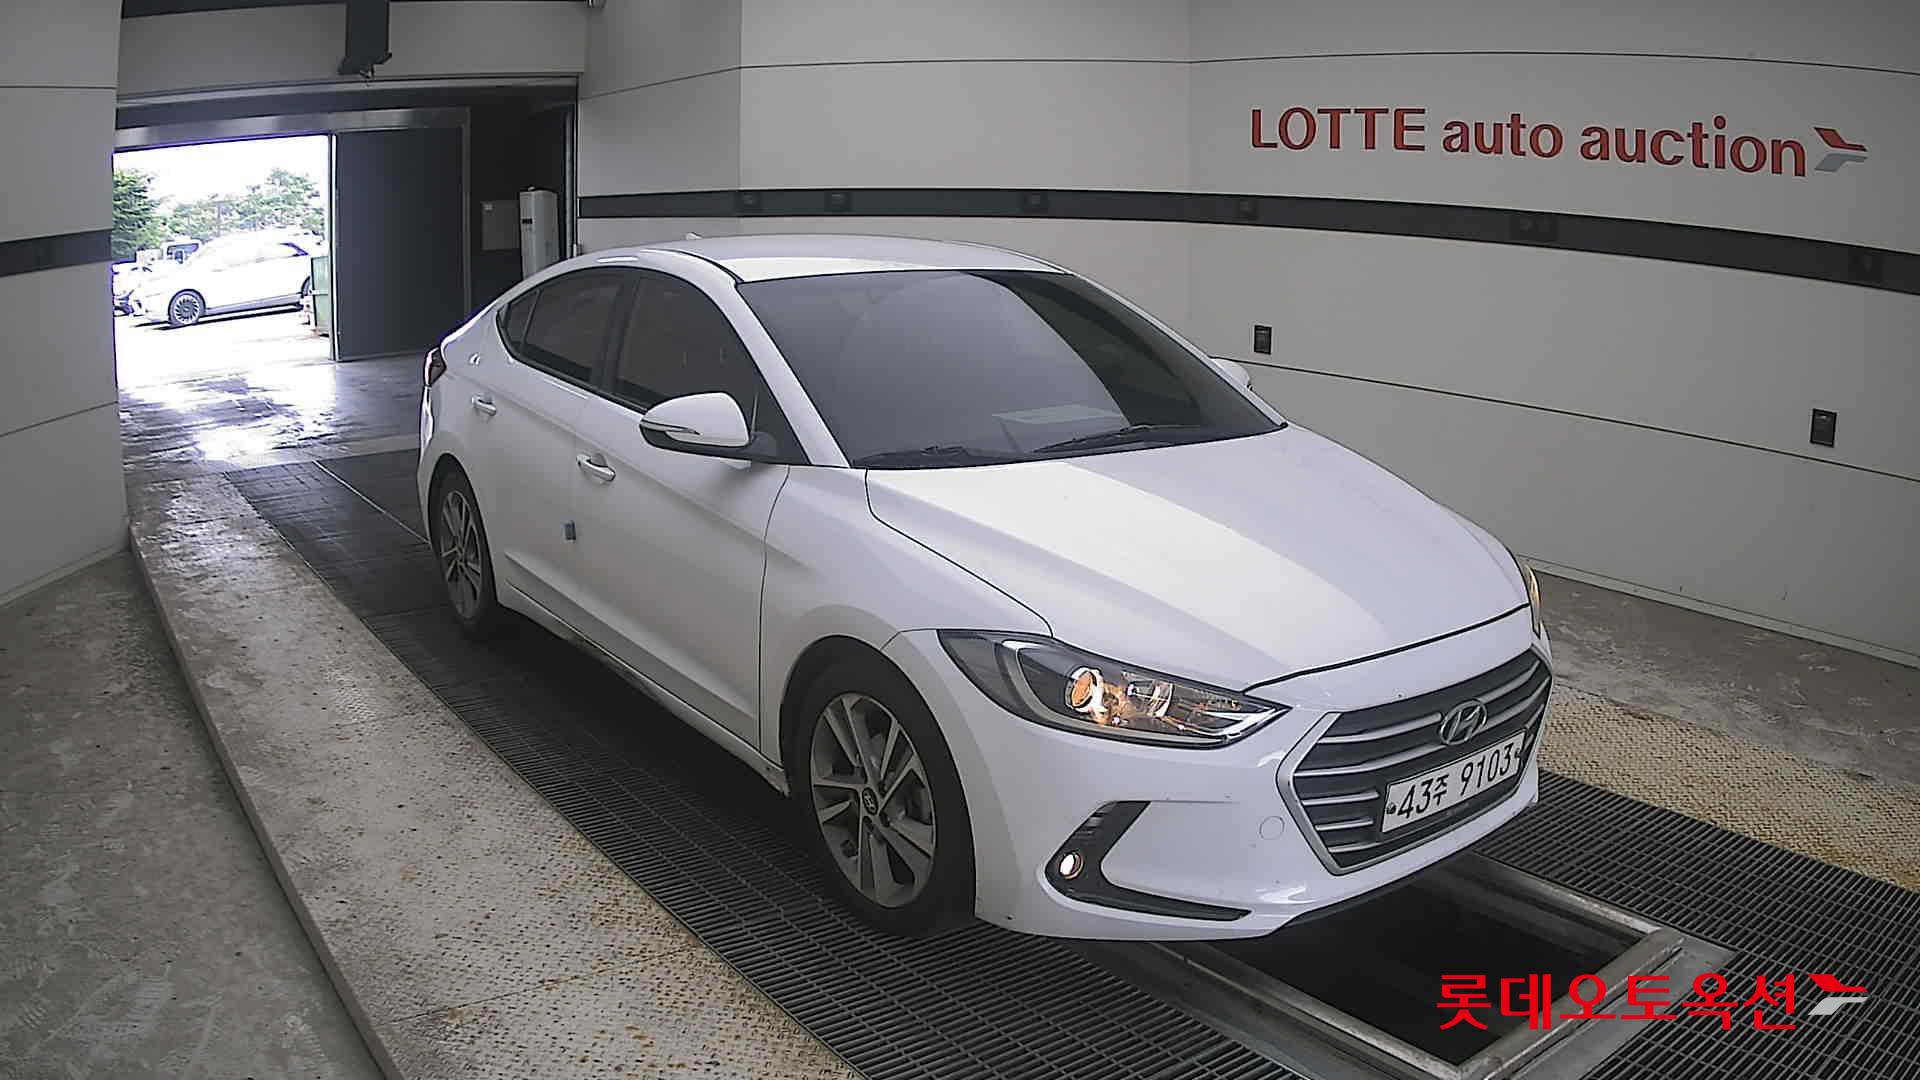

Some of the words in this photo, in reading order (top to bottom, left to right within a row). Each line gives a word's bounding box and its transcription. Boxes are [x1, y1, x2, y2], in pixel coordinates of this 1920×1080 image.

[1251, 107, 1426, 152] LOTTE
[1441, 113, 1564, 159] auto
[1579, 115, 1807, 177] auction
[1397, 774, 1449, 819] 43주
[1460, 742, 1515, 796] 9103
